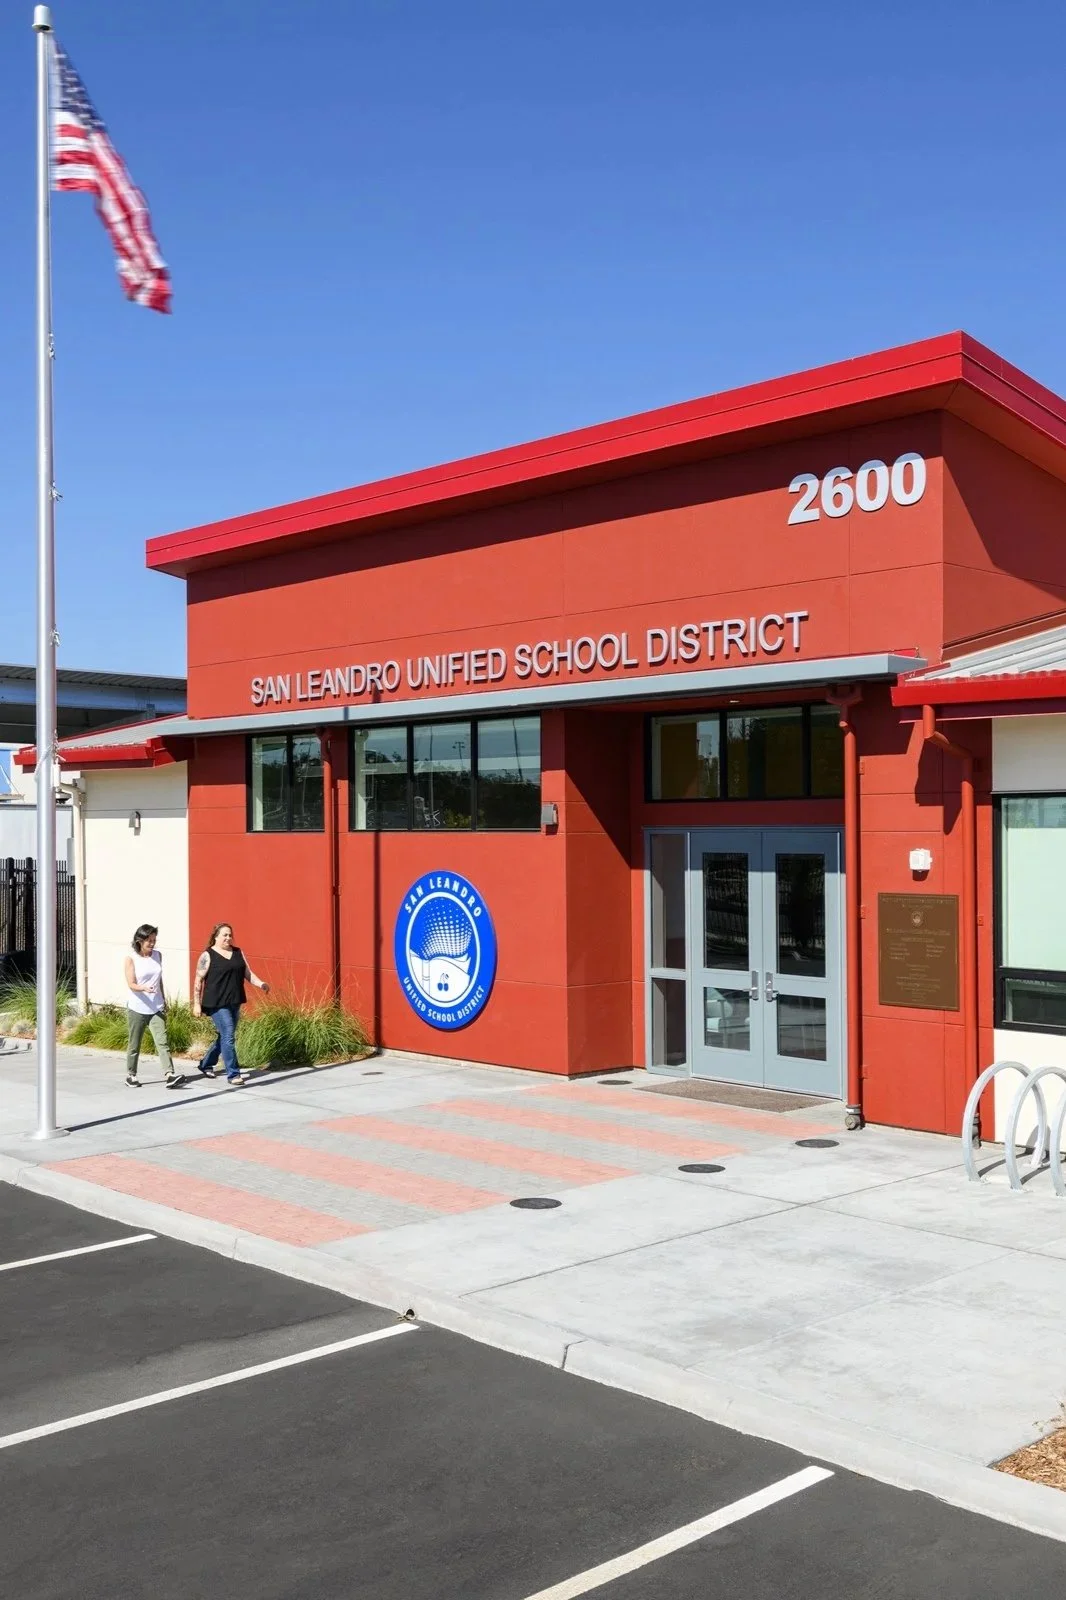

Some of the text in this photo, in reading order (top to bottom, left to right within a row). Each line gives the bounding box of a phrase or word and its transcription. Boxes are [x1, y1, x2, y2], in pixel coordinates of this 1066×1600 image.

[788, 452, 926, 525] 2600
[251, 611, 809, 704] SAN LEANDRO UNIFIED SCHOOL DISTRICT
[405, 876, 482, 917] SAN LEANDRO
[403, 976, 485, 1022] UNIFIED SCHOOL DISTRICT
